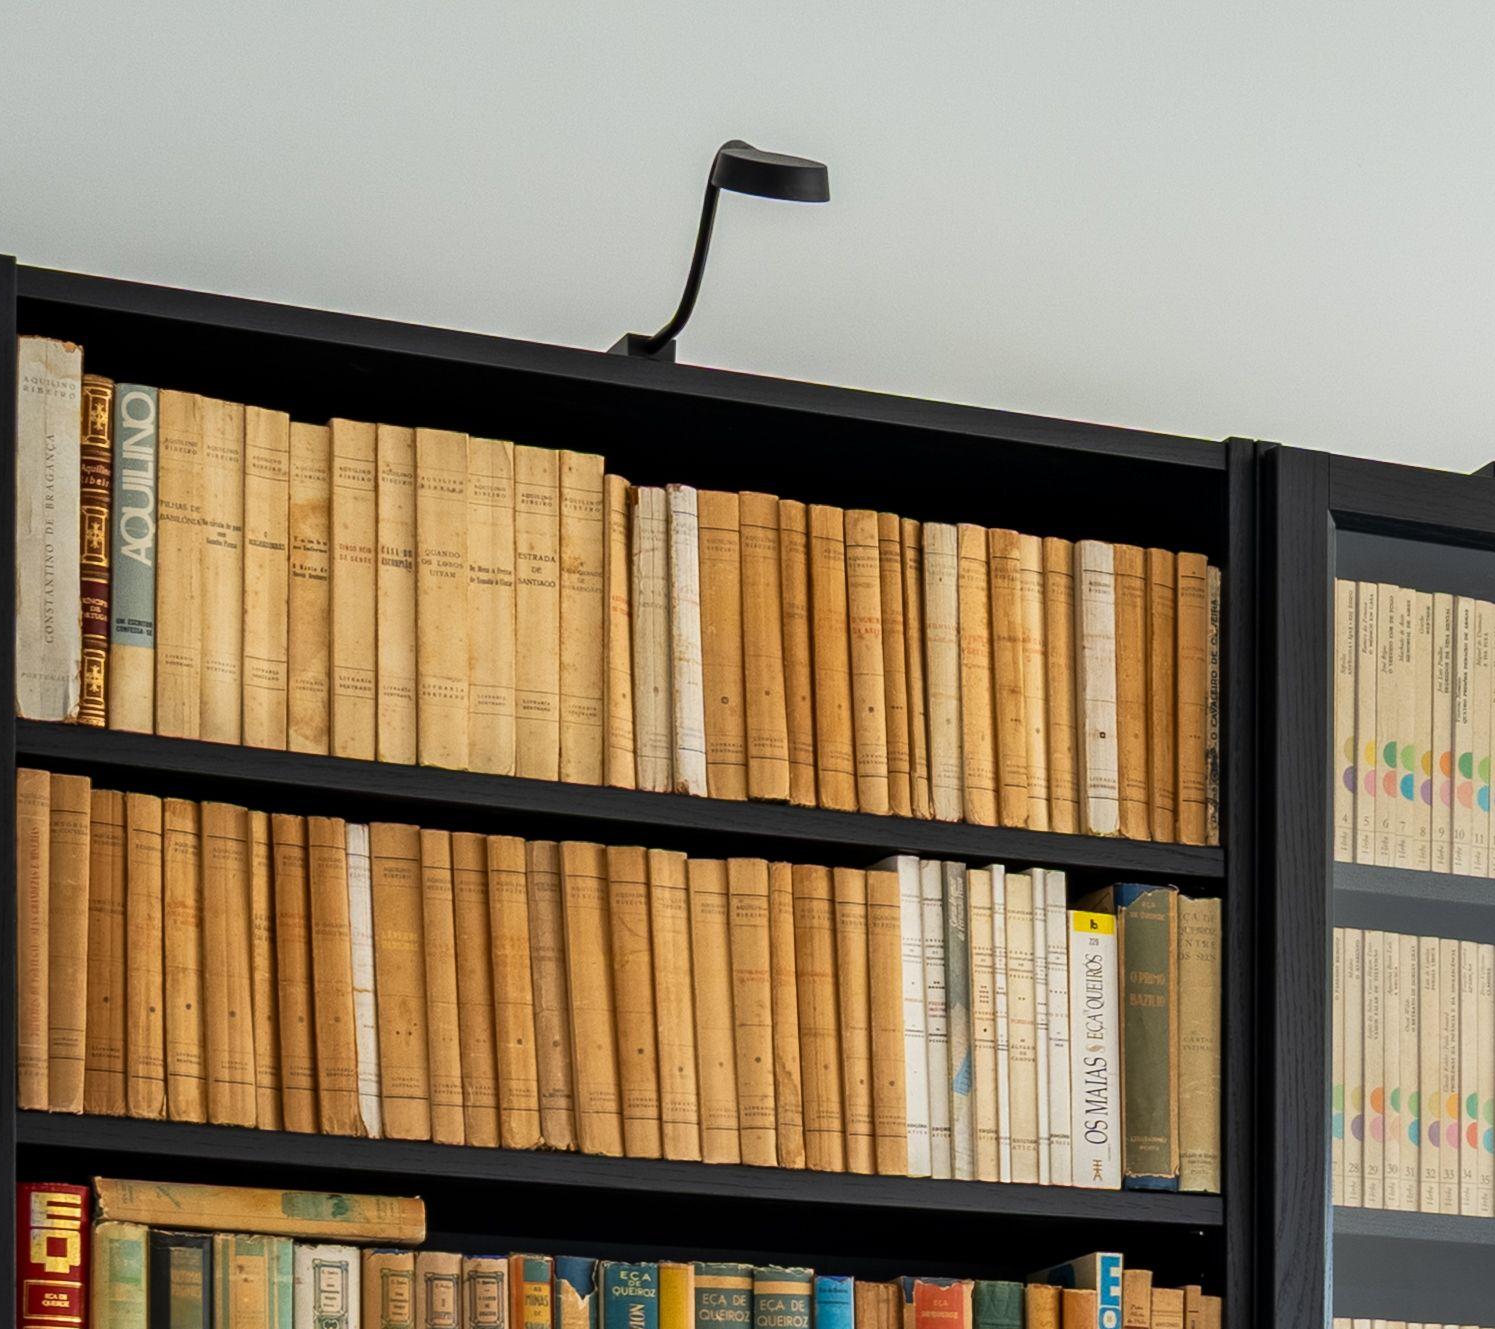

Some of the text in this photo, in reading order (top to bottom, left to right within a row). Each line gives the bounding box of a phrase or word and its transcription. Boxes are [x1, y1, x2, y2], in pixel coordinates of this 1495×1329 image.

[118, 390, 156, 565] AQUILINO
[1082, 1056, 1108, 1146] OS MAIAS
